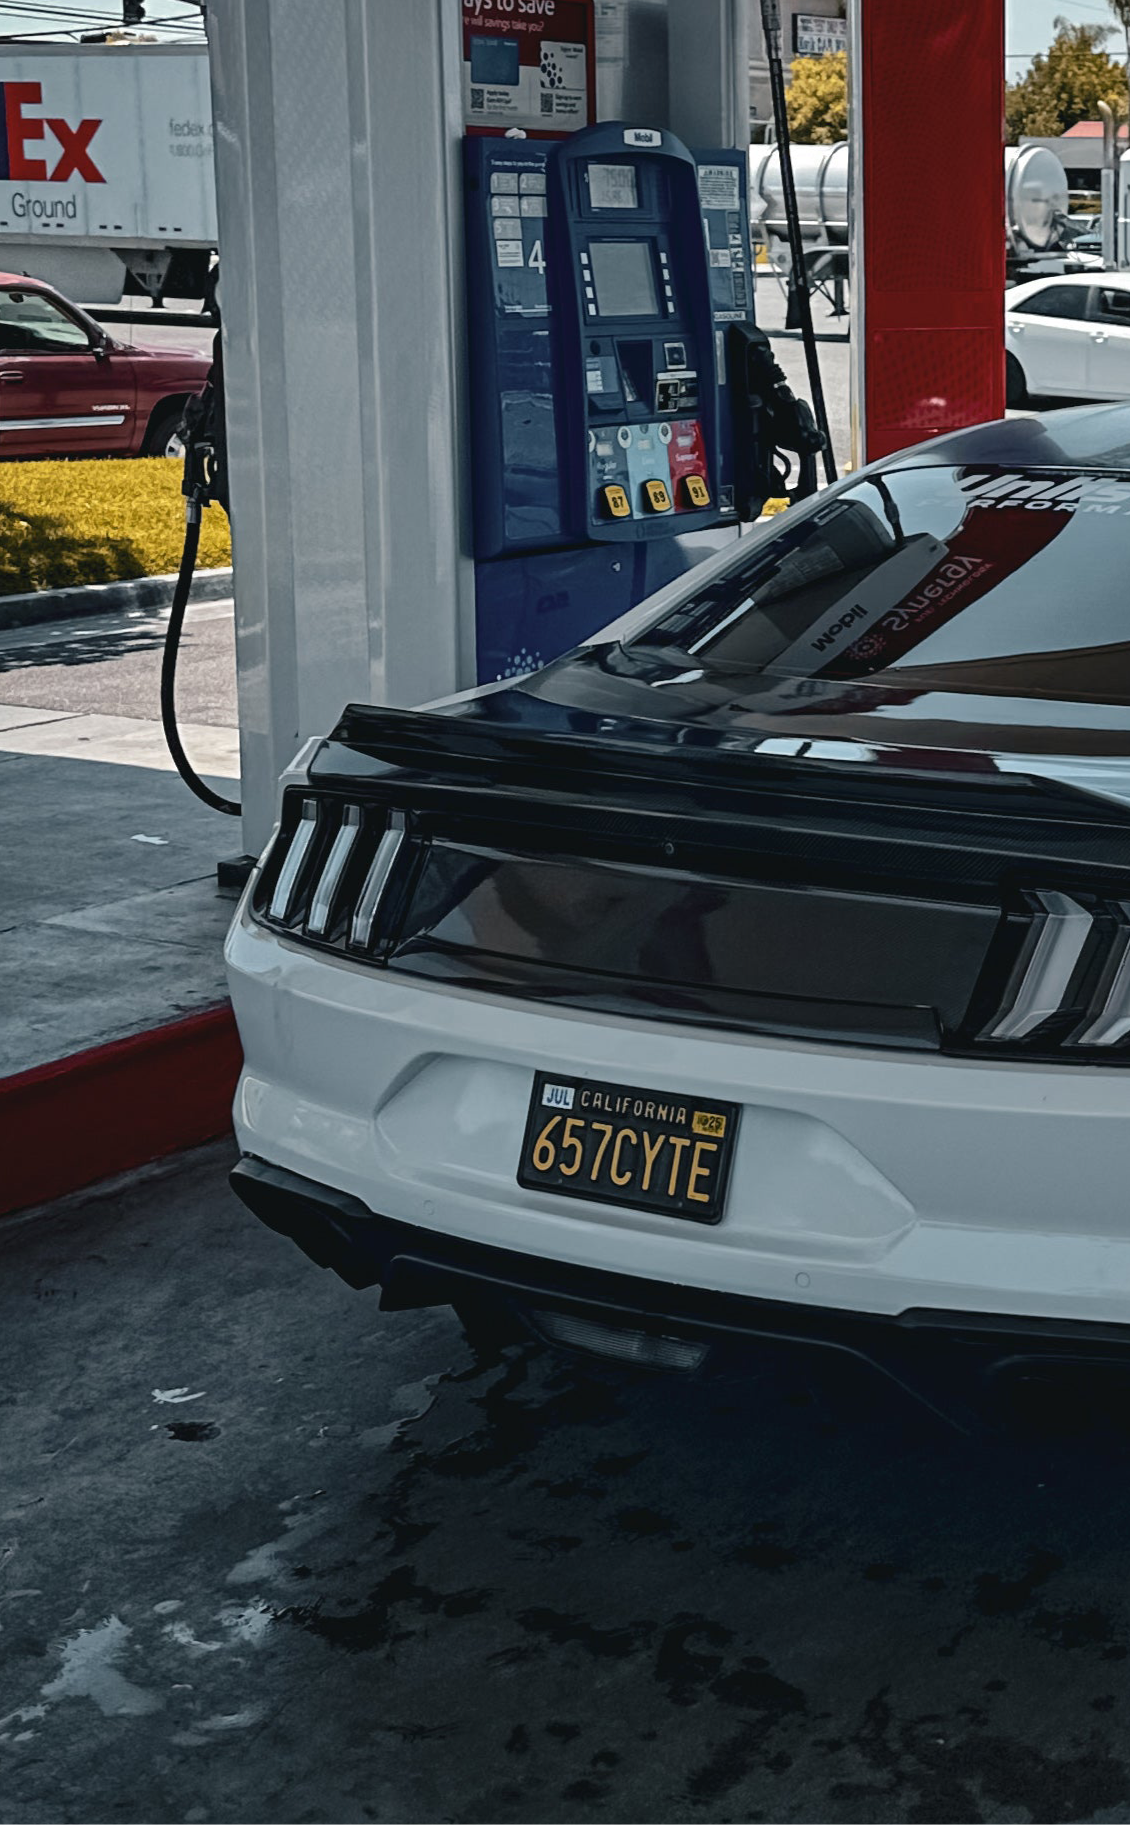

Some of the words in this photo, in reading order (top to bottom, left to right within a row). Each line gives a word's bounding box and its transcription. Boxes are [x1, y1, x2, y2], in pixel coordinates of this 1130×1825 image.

[518, 0, 555, 15] save
[0, 82, 107, 183] Ex
[634, 132, 653, 143] Mobil
[12, 193, 77, 219] Ground
[528, 239, 546, 274] 4
[611, 496, 624, 508] 87
[652, 491, 666, 504] 89
[692, 486, 705, 499] 91
[546, 1086, 571, 1106] JUL
[580, 1090, 687, 1125] CALIFORNIA
[532, 1116, 718, 1203] 657CYTE
